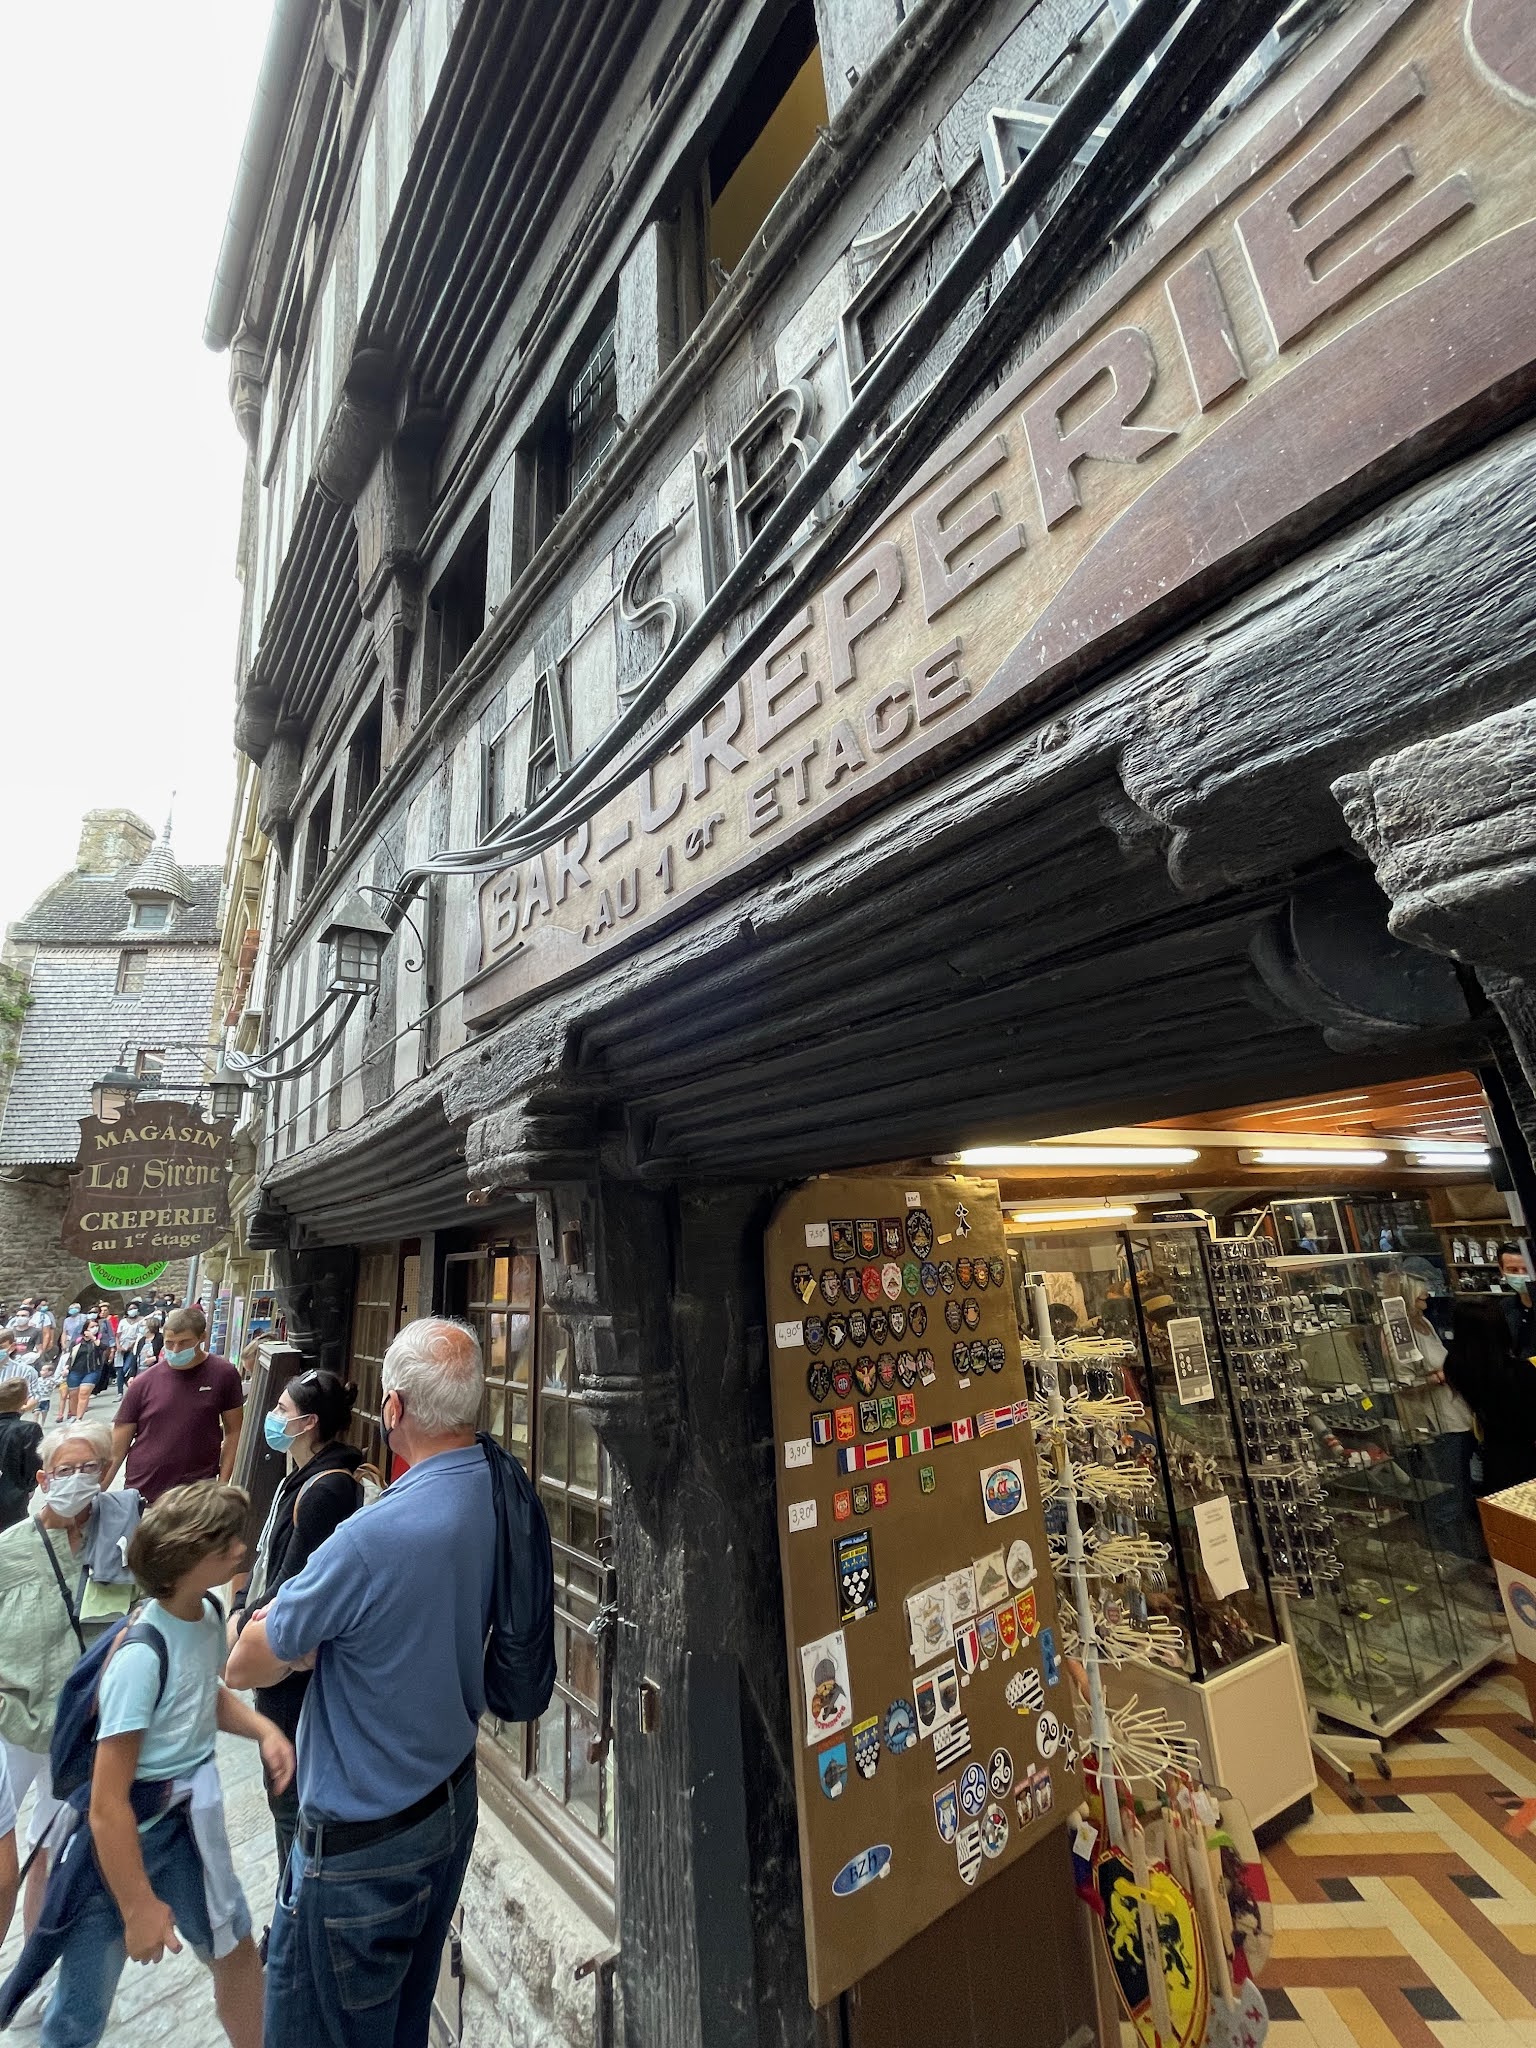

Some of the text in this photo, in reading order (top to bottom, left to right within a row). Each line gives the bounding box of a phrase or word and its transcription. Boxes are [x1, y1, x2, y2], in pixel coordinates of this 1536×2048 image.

[594, 866, 640, 937] AU
[746, 635, 971, 839] ETAGE
[94, 1125, 222, 1150] MAGASIN
[86, 1157, 221, 1196] La Sirène
[79, 1206, 217, 1232] CREPERIE
[91, 1231, 201, 1251] au 1er étage
[778, 1323, 801, 1341] 4,90€
[789, 1441, 811, 1462] 3,90€
[791, 1503, 815, 1526] 3,20€
[955, 1623, 974, 1638] FRANCE
